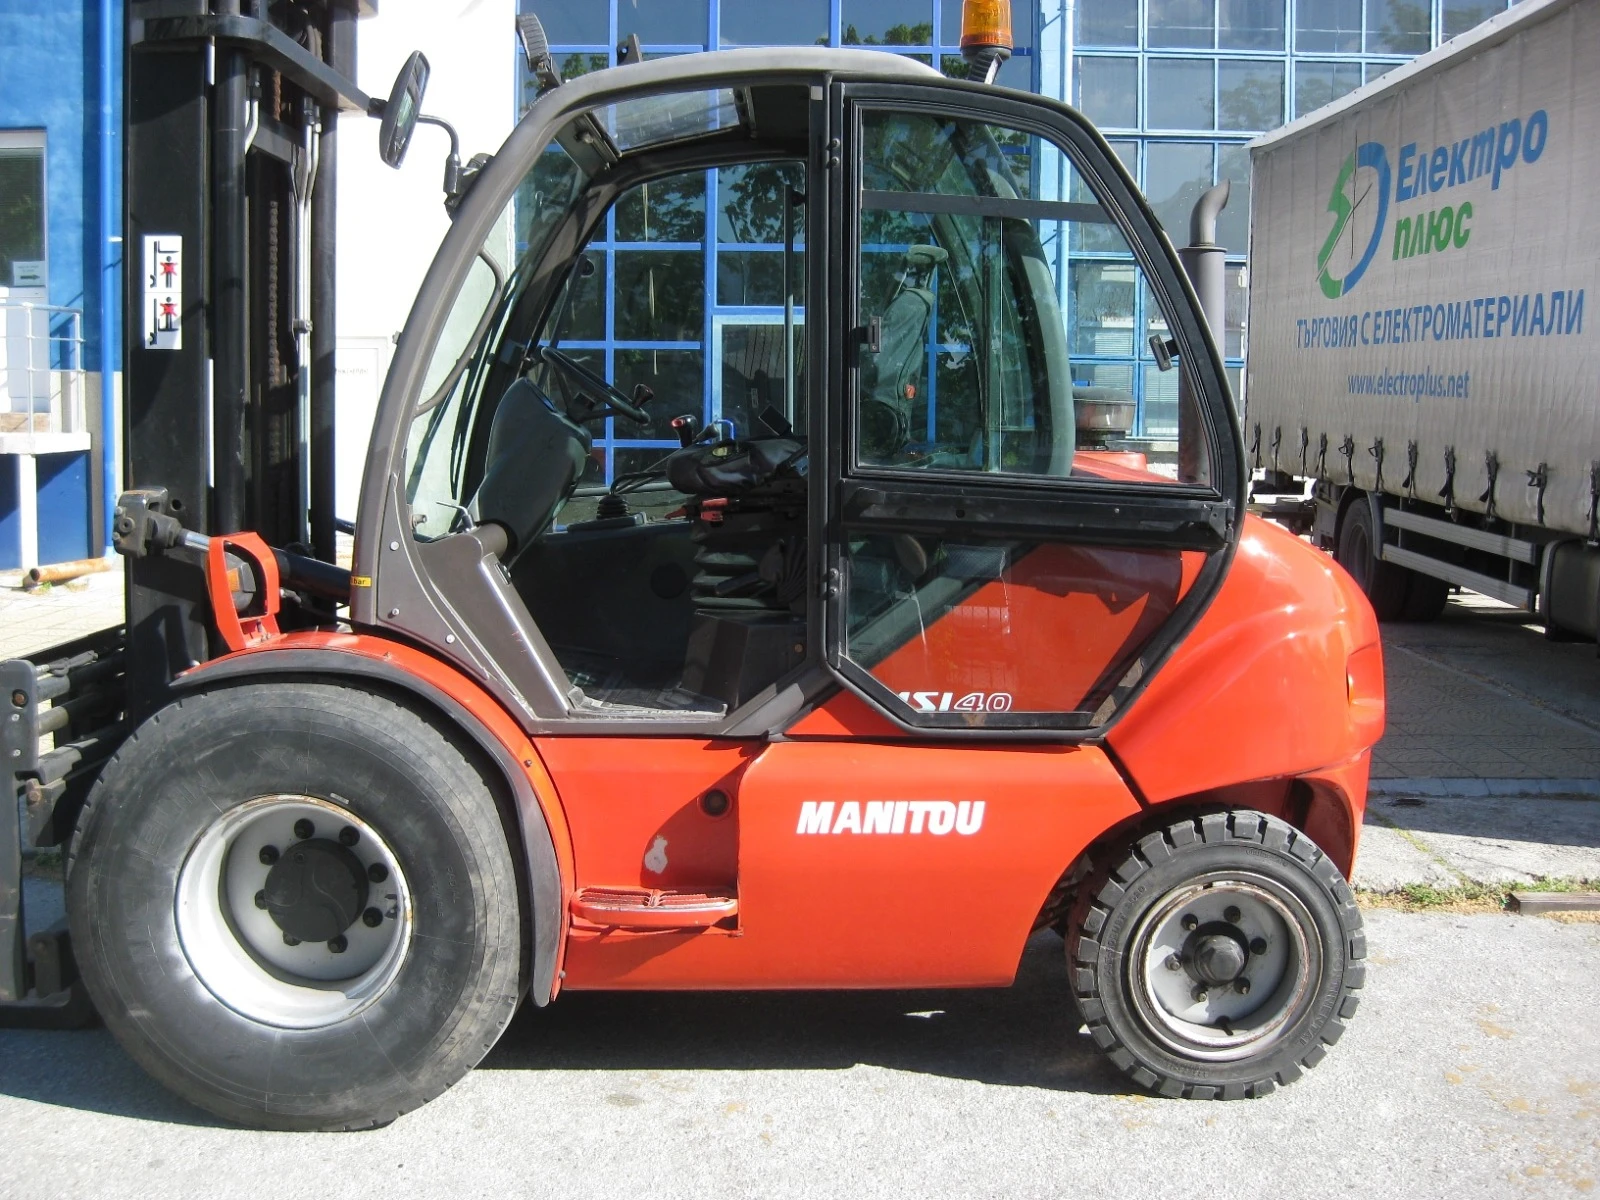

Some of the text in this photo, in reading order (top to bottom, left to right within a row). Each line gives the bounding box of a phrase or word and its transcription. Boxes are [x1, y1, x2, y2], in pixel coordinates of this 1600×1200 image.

[1396, 109, 1547, 203] Електро
[1392, 201, 1473, 260] плюс
[1296, 288, 1585, 348] ТЪРГОВИЯ С ЕЛЕКТРОМАТЕРИАЛИ
[1347, 365, 1470, 403] www.electroplus.net
[796, 801, 986, 835] MANITOU
